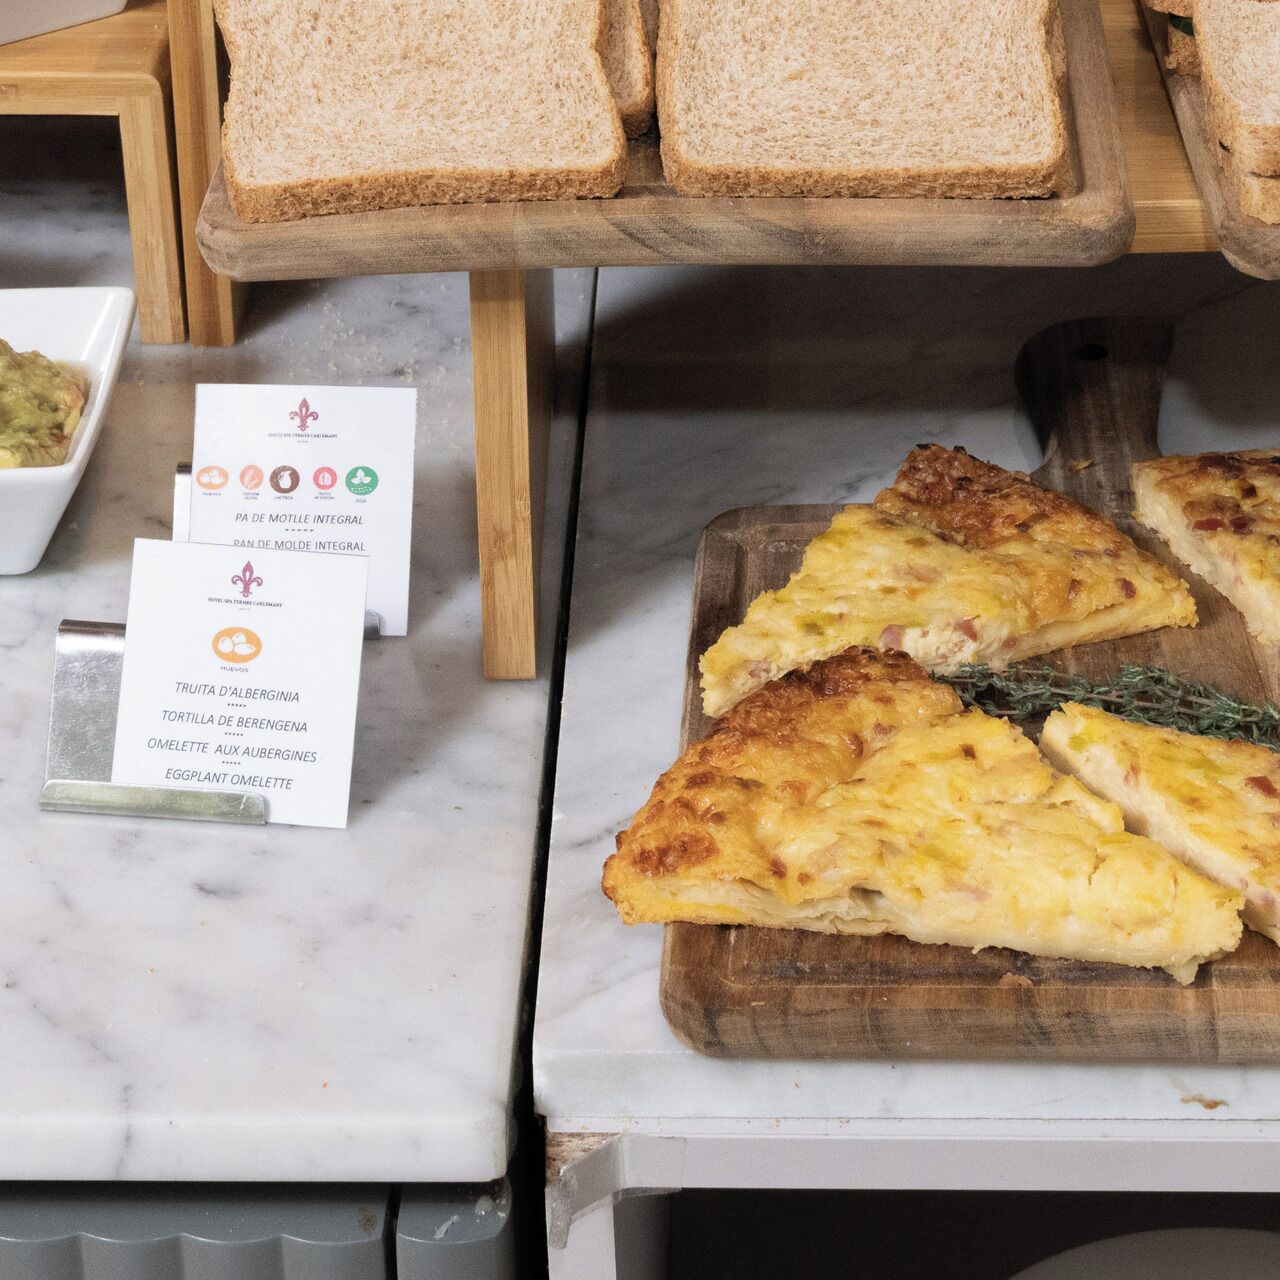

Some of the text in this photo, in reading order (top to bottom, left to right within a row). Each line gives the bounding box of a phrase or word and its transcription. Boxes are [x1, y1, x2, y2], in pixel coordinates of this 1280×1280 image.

[235, 512, 364, 525] PA DE MOTLLE INTEGRAL
[274, 540, 312, 550] MOLDE
[315, 541, 366, 552] INTEGRAL
[175, 682, 300, 703] TRUITA D'ALBERGINIA
[162, 710, 308, 733] TORTILLA DE BERENGENA
[147, 737, 317, 763] OMELETTE AUX AUBERGINES
[165, 768, 293, 790] EGGPLANT OMELETTE
